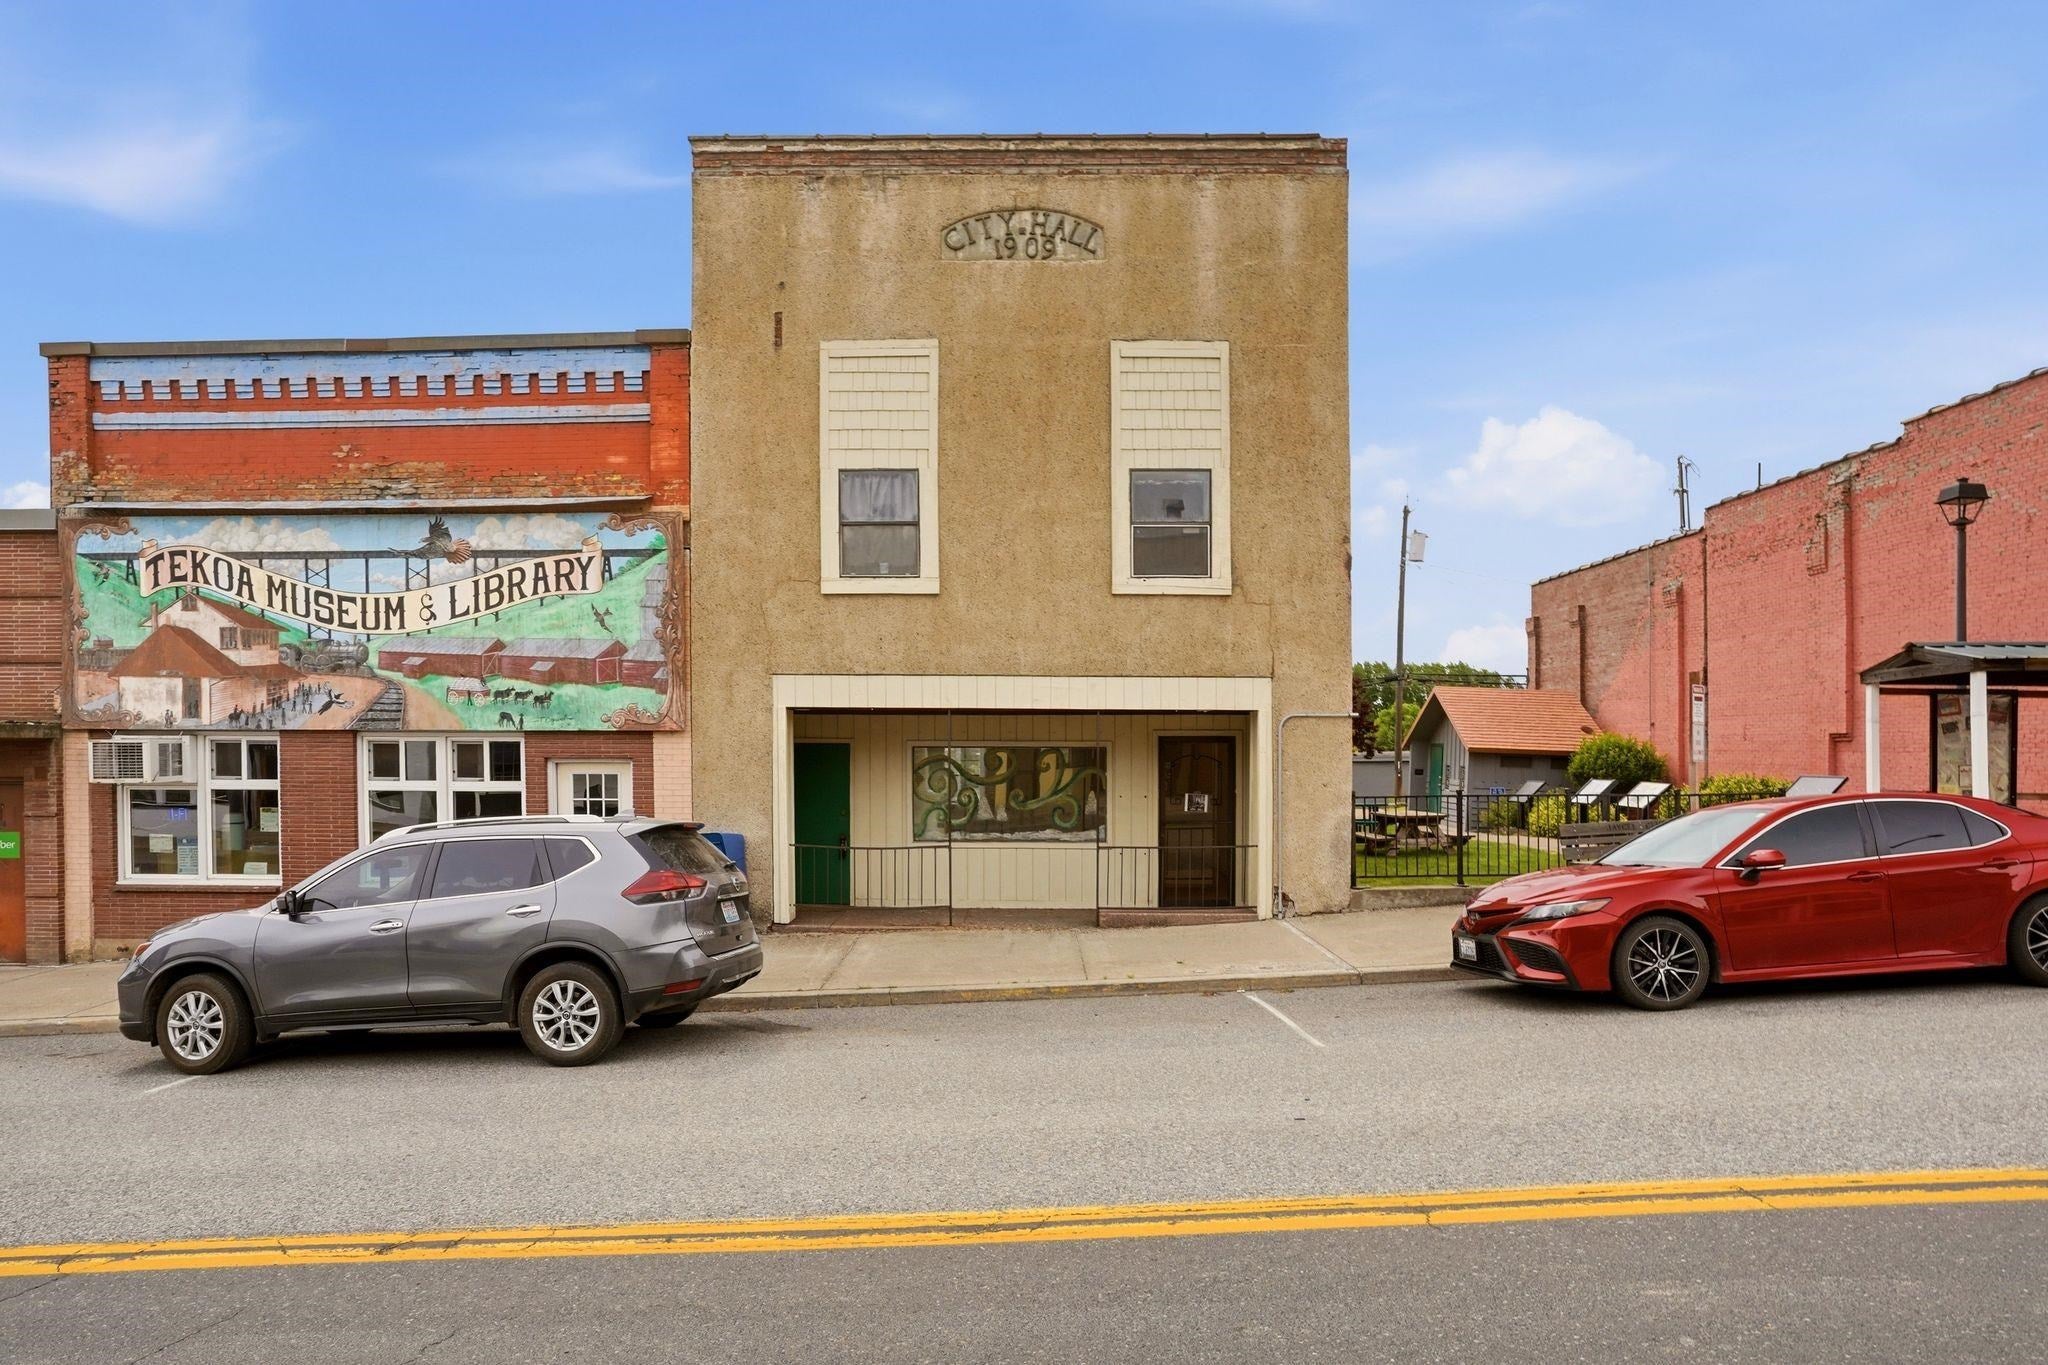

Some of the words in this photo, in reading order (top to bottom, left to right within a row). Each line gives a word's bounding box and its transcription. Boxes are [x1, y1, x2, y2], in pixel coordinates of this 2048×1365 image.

[944, 212, 1015, 251] CITY
[1029, 212, 1098, 255] HALL
[995, 237, 1056, 260] 1909
[145, 549, 256, 603] TEKOA
[266, 574, 406, 631] MUSEUM
[419, 592, 437, 625] &
[449, 555, 595, 620] LIBRARY
[0, 840, 16, 849] ber
